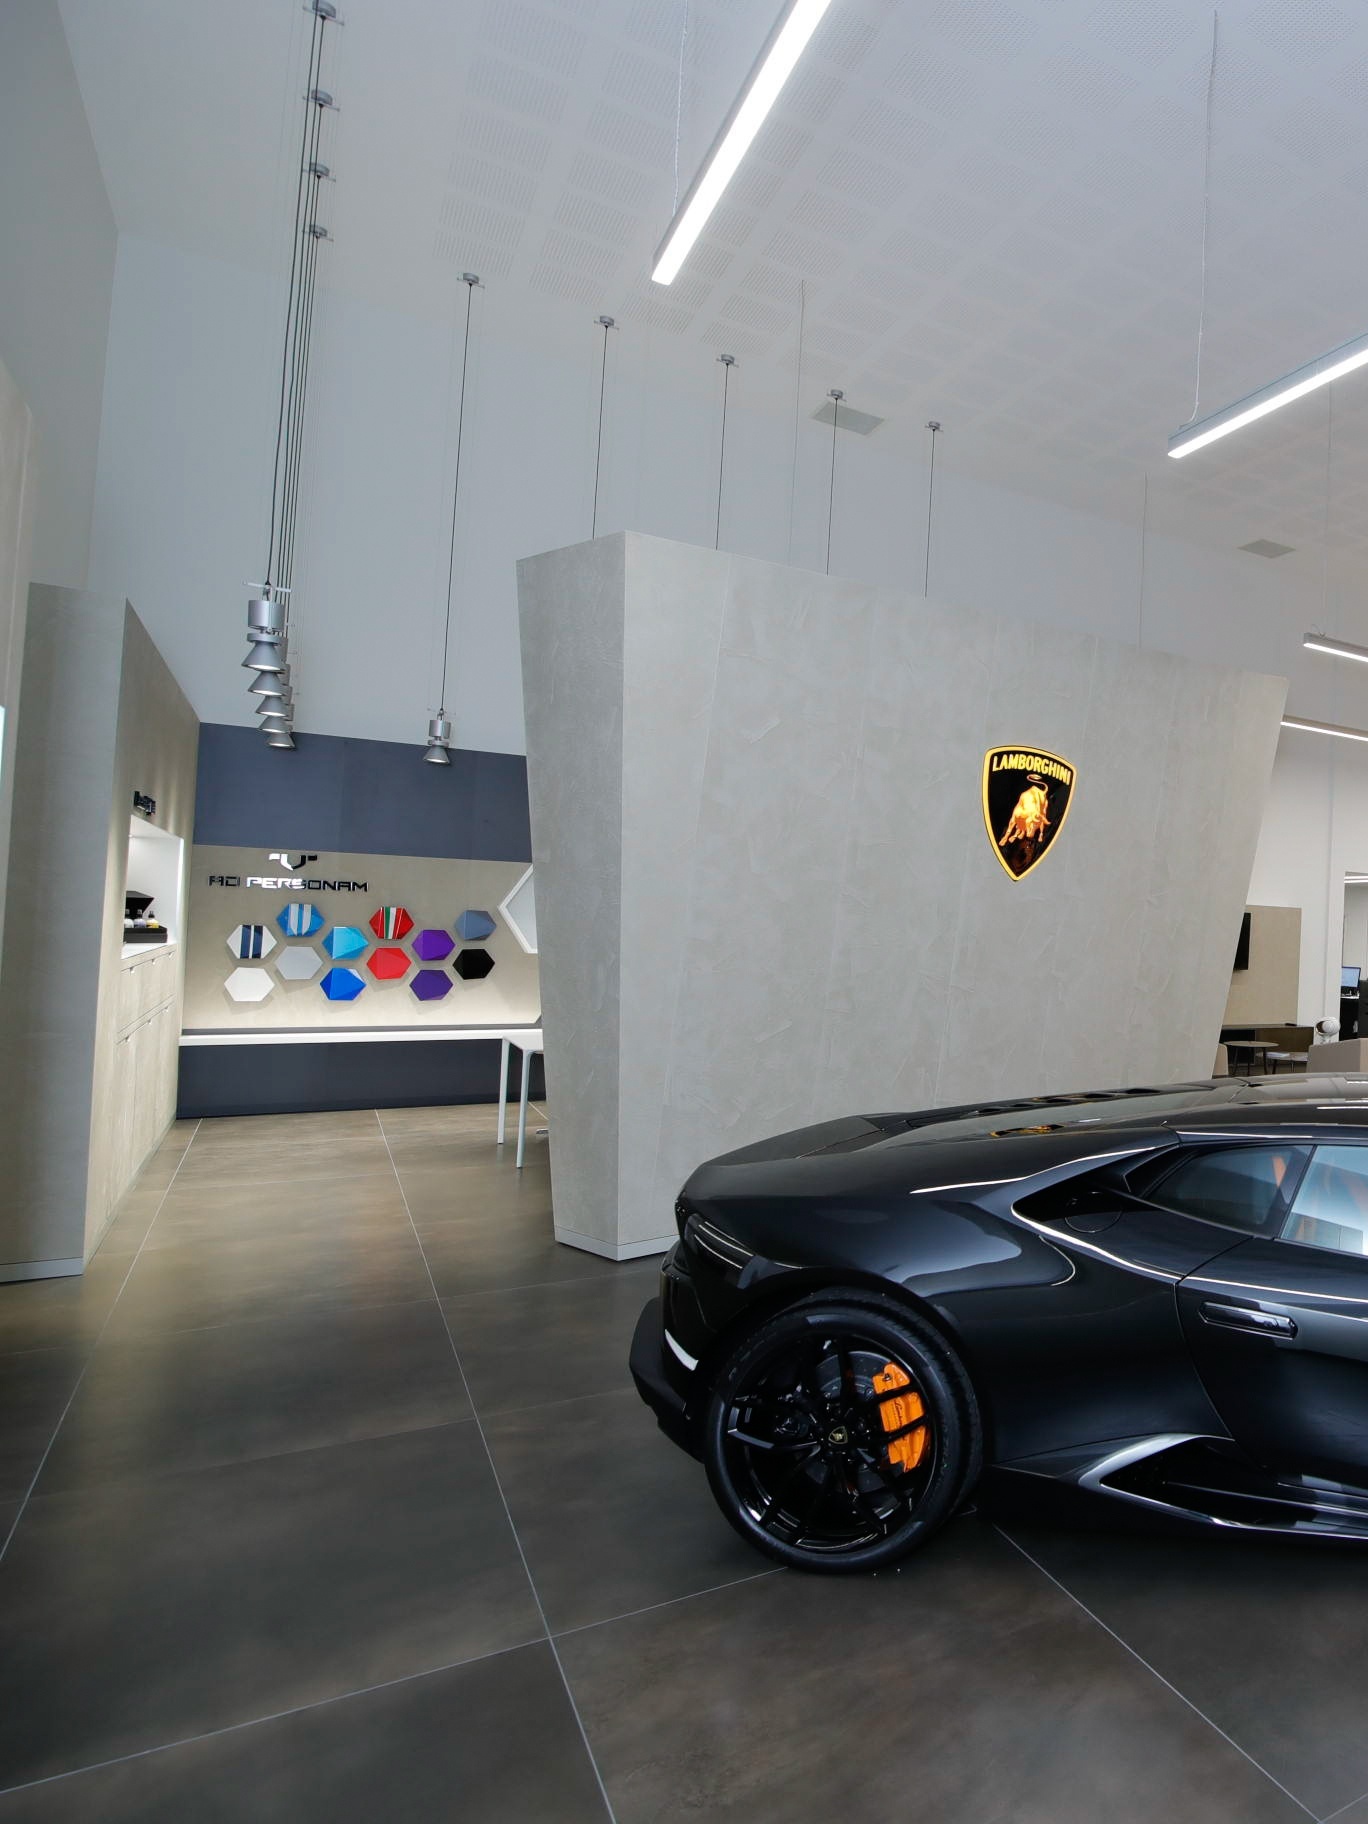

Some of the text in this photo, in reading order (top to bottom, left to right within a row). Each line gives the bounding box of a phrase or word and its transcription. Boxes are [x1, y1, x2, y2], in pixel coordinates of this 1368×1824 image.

[992, 754, 1072, 786] LAMBORGHINI
[208, 875, 369, 893] AD PERSONAM
